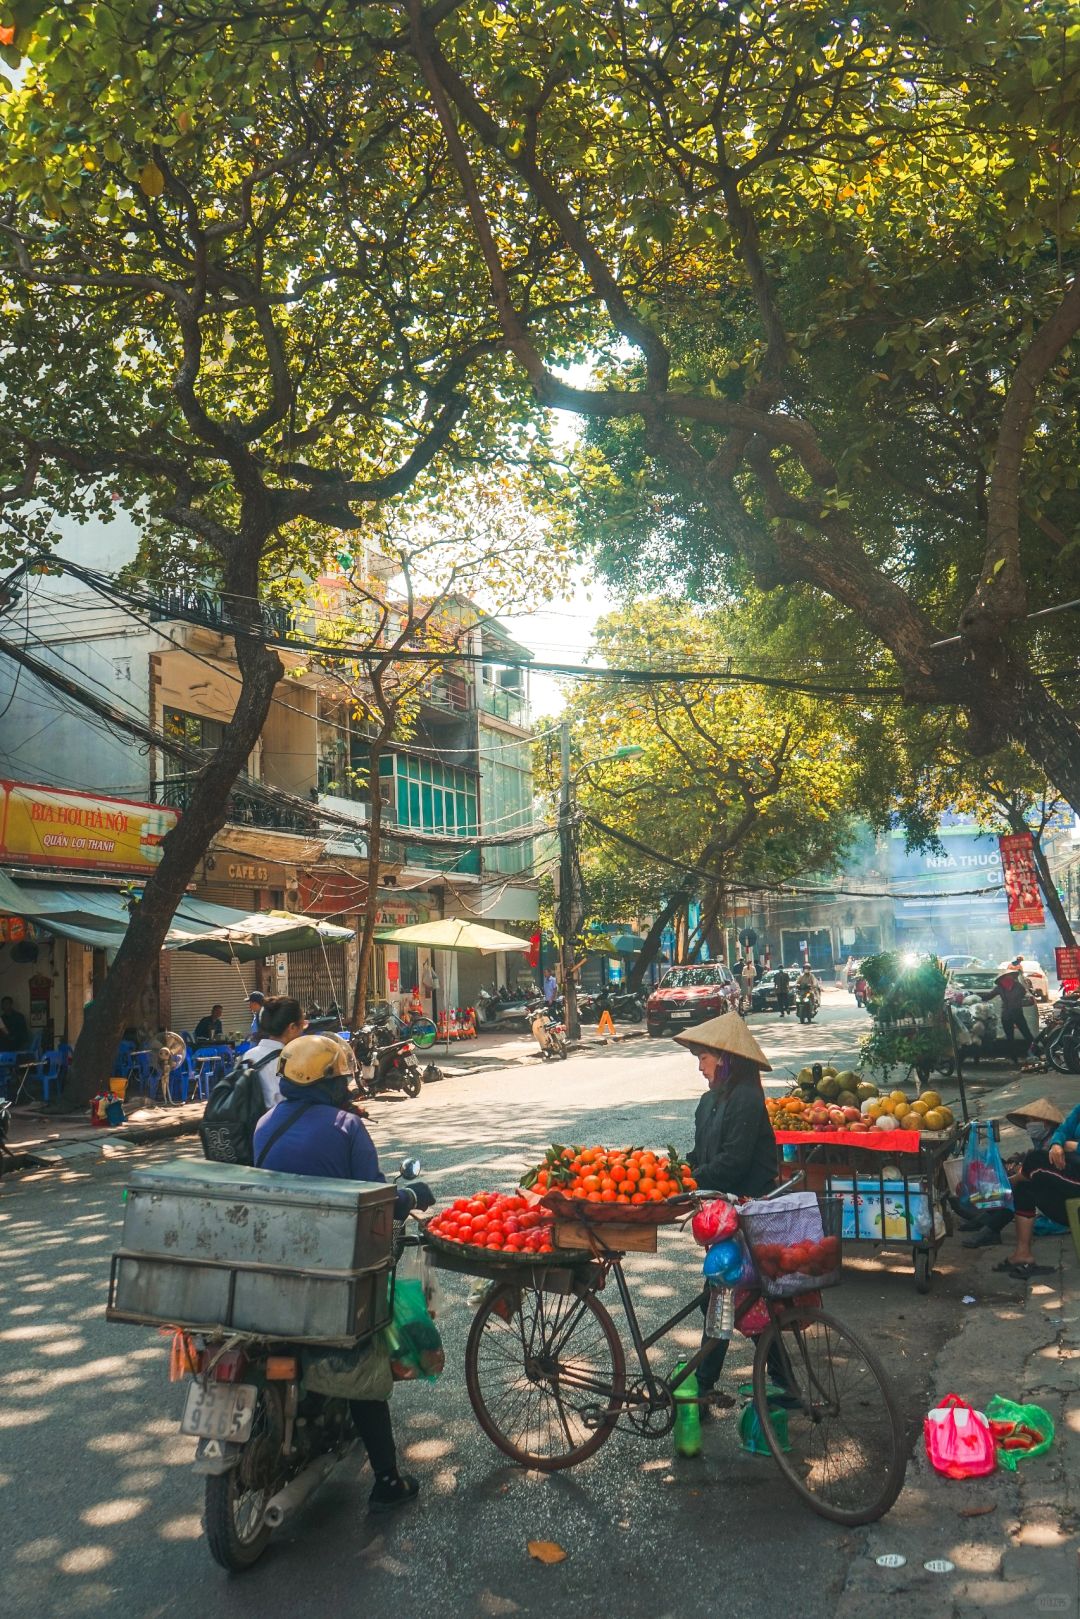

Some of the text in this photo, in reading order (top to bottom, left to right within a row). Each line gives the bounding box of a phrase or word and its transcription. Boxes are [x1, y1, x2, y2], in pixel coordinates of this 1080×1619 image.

[31, 802, 128, 836] BIA HƠI HÀ NỘI
[43, 832, 115, 852] QUÁN LỢI THANH
[926, 849, 1003, 868] NHÀ THUỐ
[228, 864, 256, 880] CAFE
